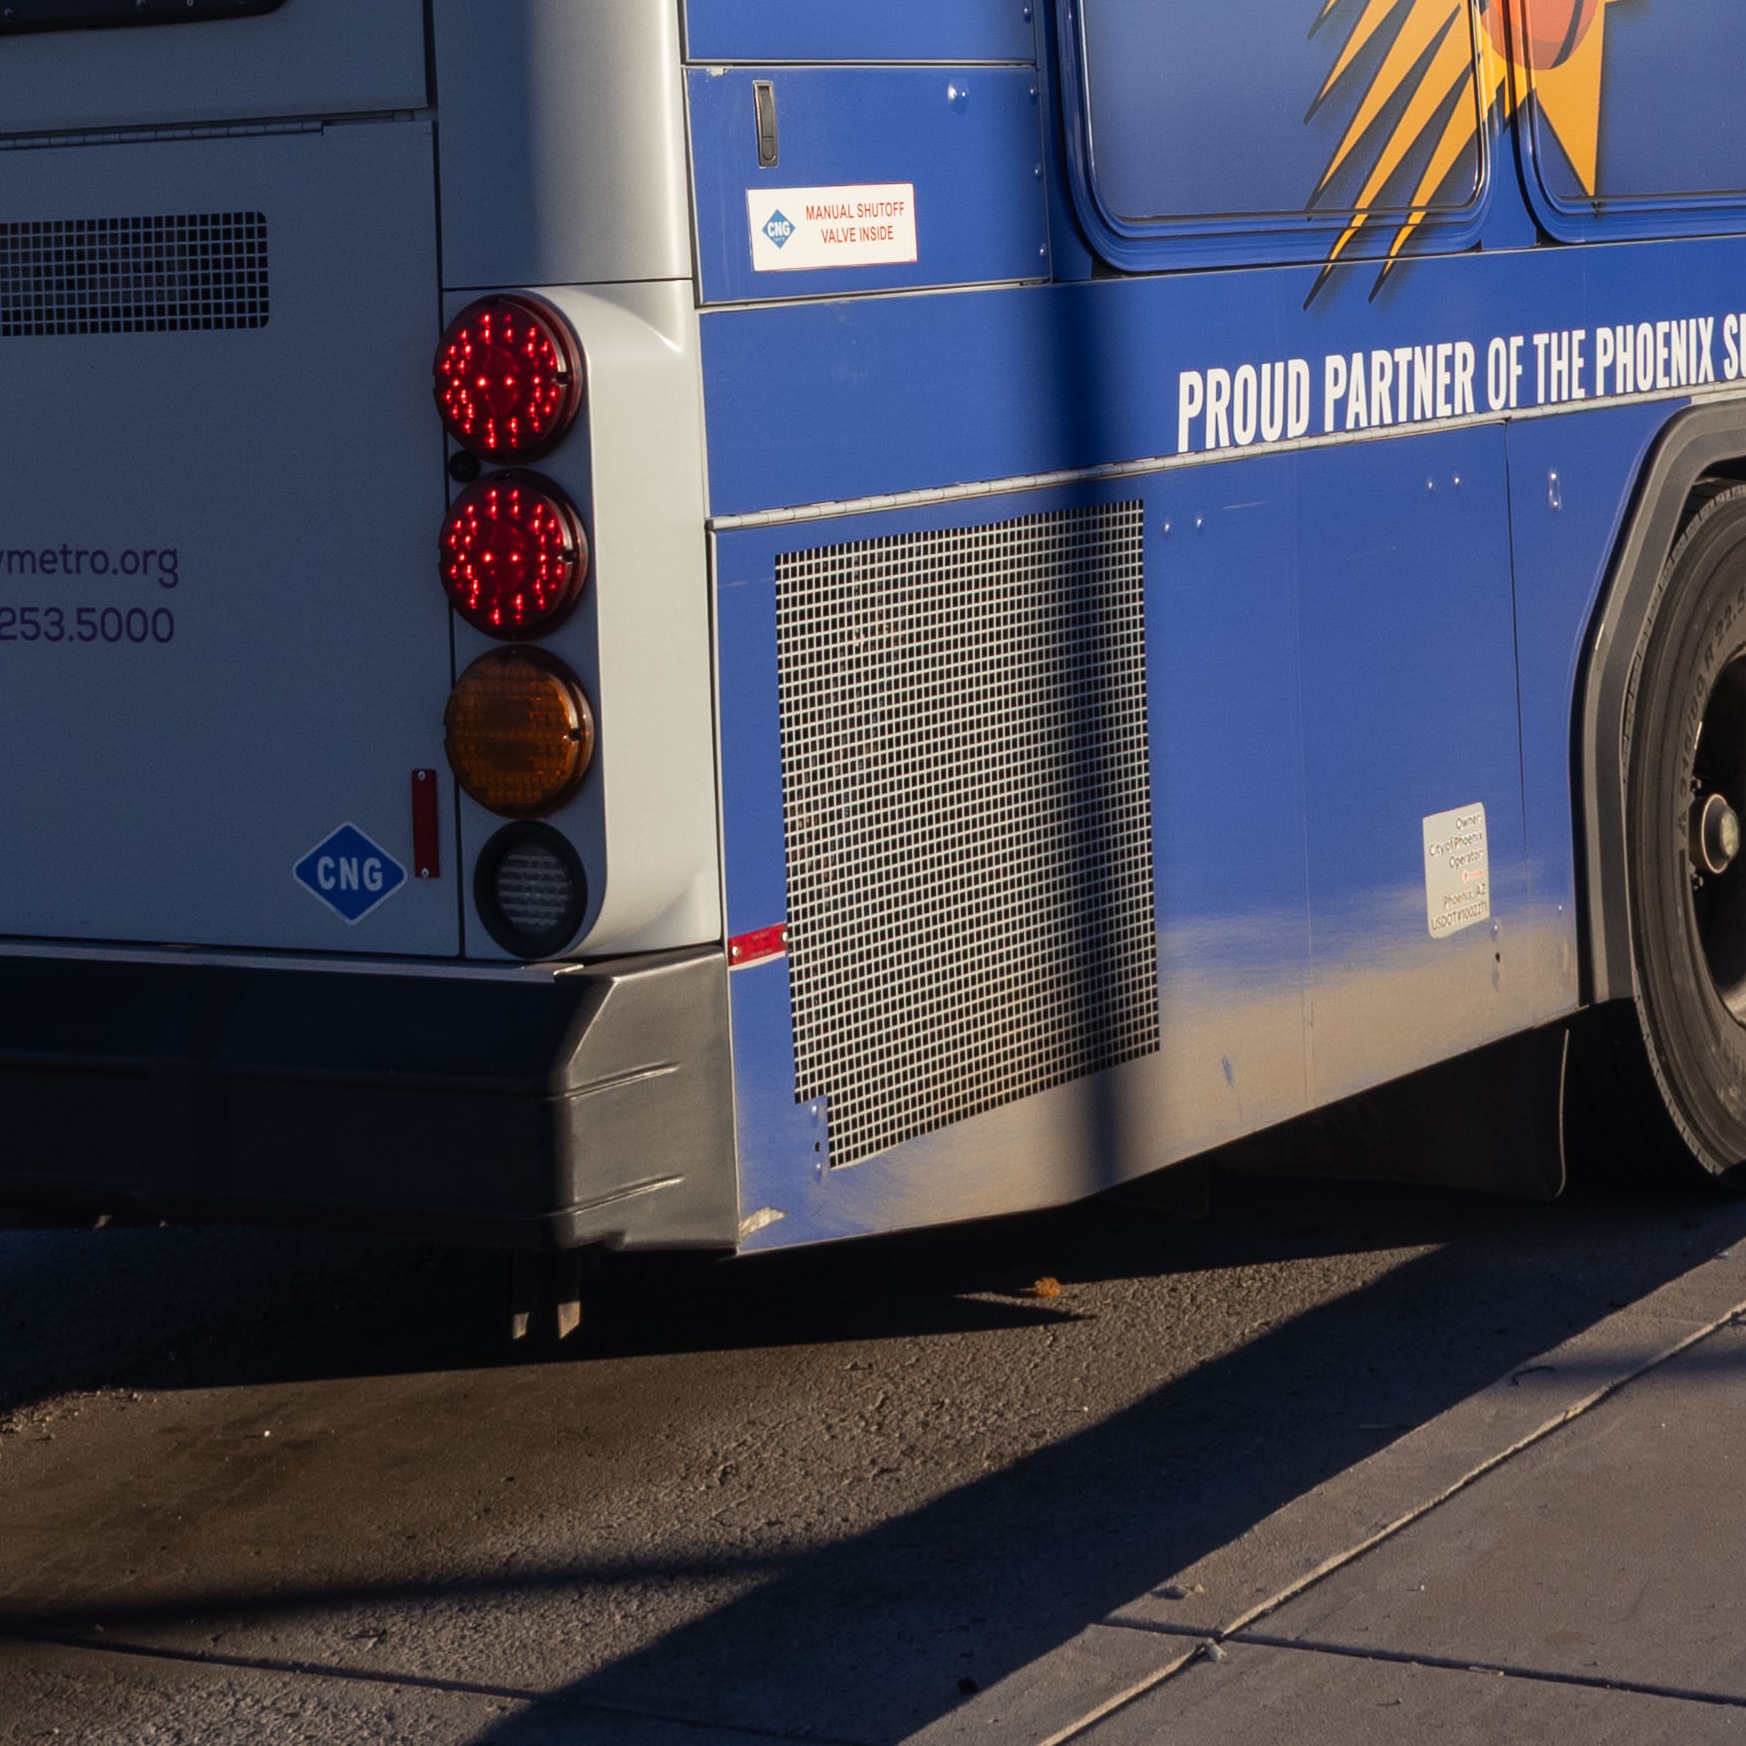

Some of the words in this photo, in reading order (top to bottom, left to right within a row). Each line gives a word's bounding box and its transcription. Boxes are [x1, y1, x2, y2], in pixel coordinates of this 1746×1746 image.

[806, 205, 854, 221] MANUAL
[857, 201, 905, 218] SHUTOFF
[767, 221, 791, 237] CNG
[821, 227, 856, 244] VALVE
[859, 225, 894, 242] INSIDE
[1177, 358, 1311, 453] PROUD
[1323, 340, 1475, 432] PARTNER
[1486, 335, 1524, 411] OF
[1532, 328, 1586, 404] THE
[1594, 316, 1715, 395] PHOENIX
[317, 856, 383, 891] CNG
